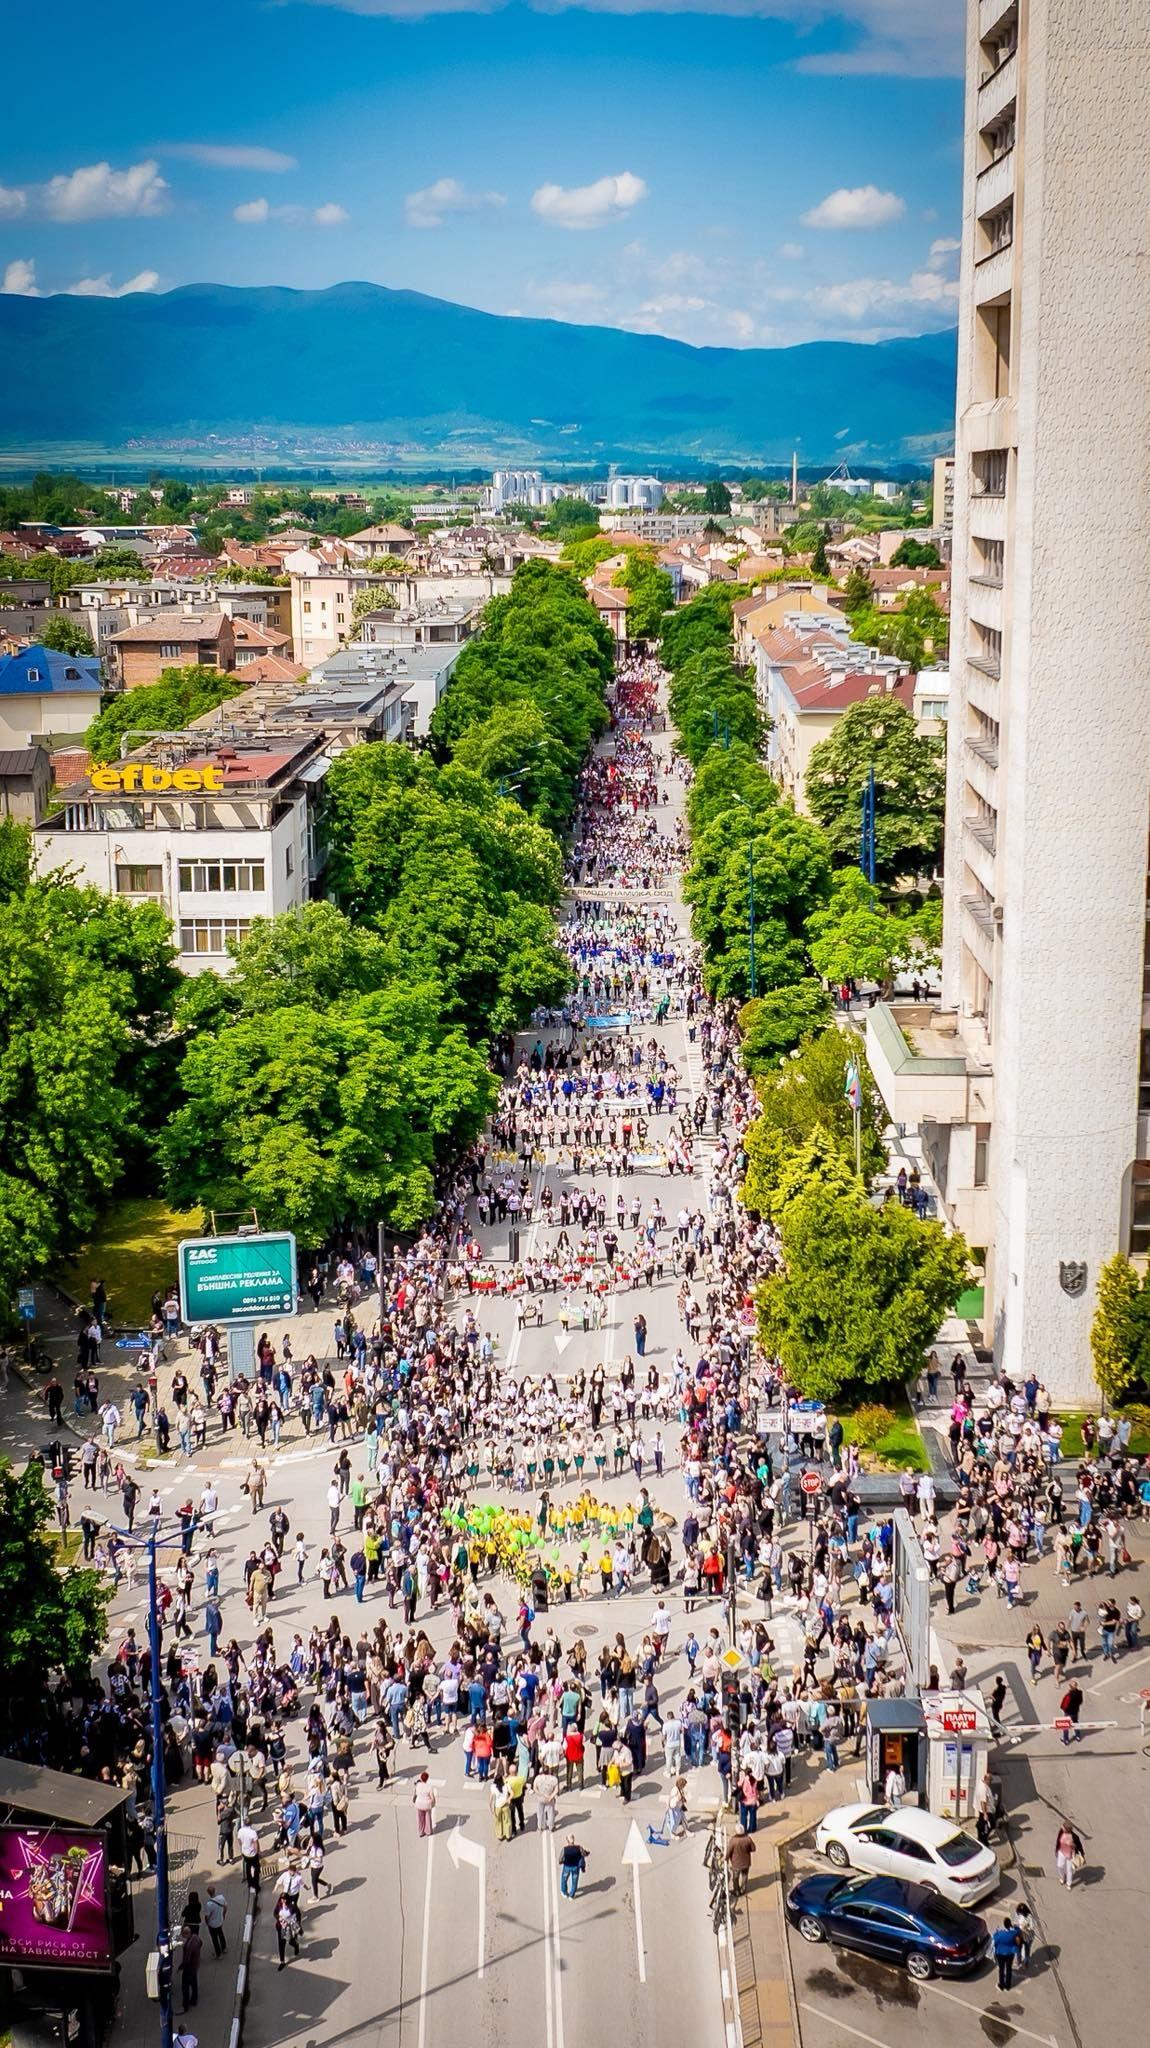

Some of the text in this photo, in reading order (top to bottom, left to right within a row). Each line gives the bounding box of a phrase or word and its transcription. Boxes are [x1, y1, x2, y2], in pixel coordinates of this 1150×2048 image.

[91, 764, 224, 791] efbet
[653, 890, 674, 898] ООД
[189, 1248, 217, 1260] ZAC
[197, 1277, 283, 1292] ВЪНШНА РЕКЛАМА
[803, 1479, 819, 1488] STOP
[945, 1713, 975, 1721] ПЛАТИ
[951, 1720, 970, 1729] ТУК
[37, 1940, 67, 1949] РИСК
[71, 1942, 87, 1950] ОТ
[1, 1945, 99, 1959] НА ЗАВИСИМОСТ
